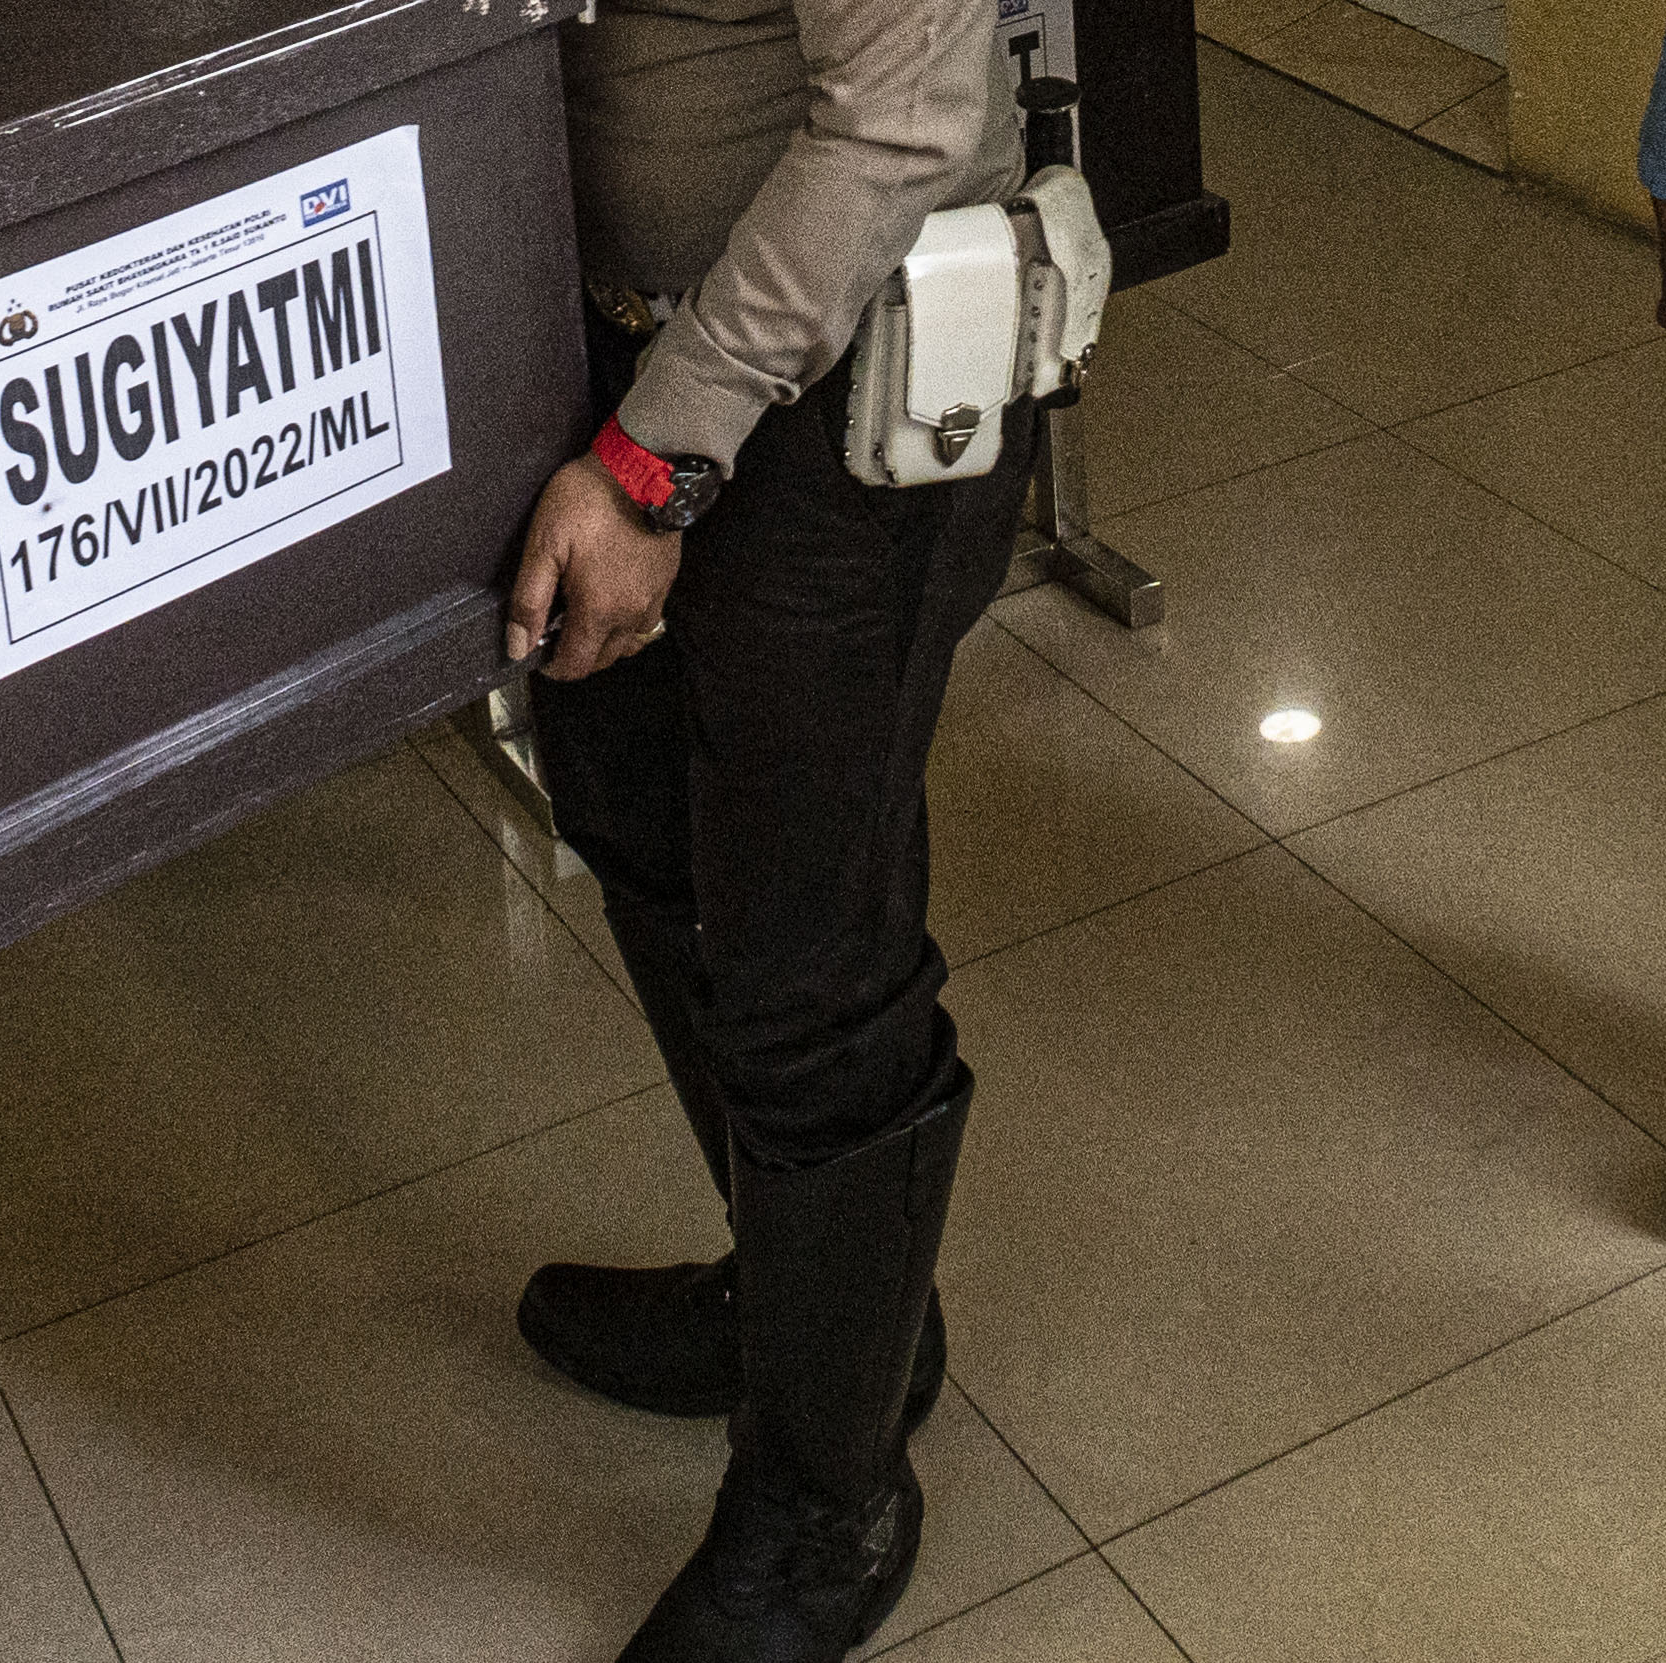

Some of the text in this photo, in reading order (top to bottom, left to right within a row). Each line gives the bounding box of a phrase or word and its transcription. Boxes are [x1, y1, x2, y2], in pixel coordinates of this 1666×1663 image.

[302, 184, 347, 216] DVI
[47, 292, 83, 312] RUMAH
[85, 280, 114, 298] SAKIT
[116, 252, 187, 286] BHAYANGKARA
[243, 213, 286, 236] SUKANTO
[65, 209, 271, 294] PUSAT KEDOKTERAN DAN KESEHATAN POLRI
[0, 238, 381, 506] SUGIYATMI
[11, 389, 390, 593] 176/VII/2022/ML
